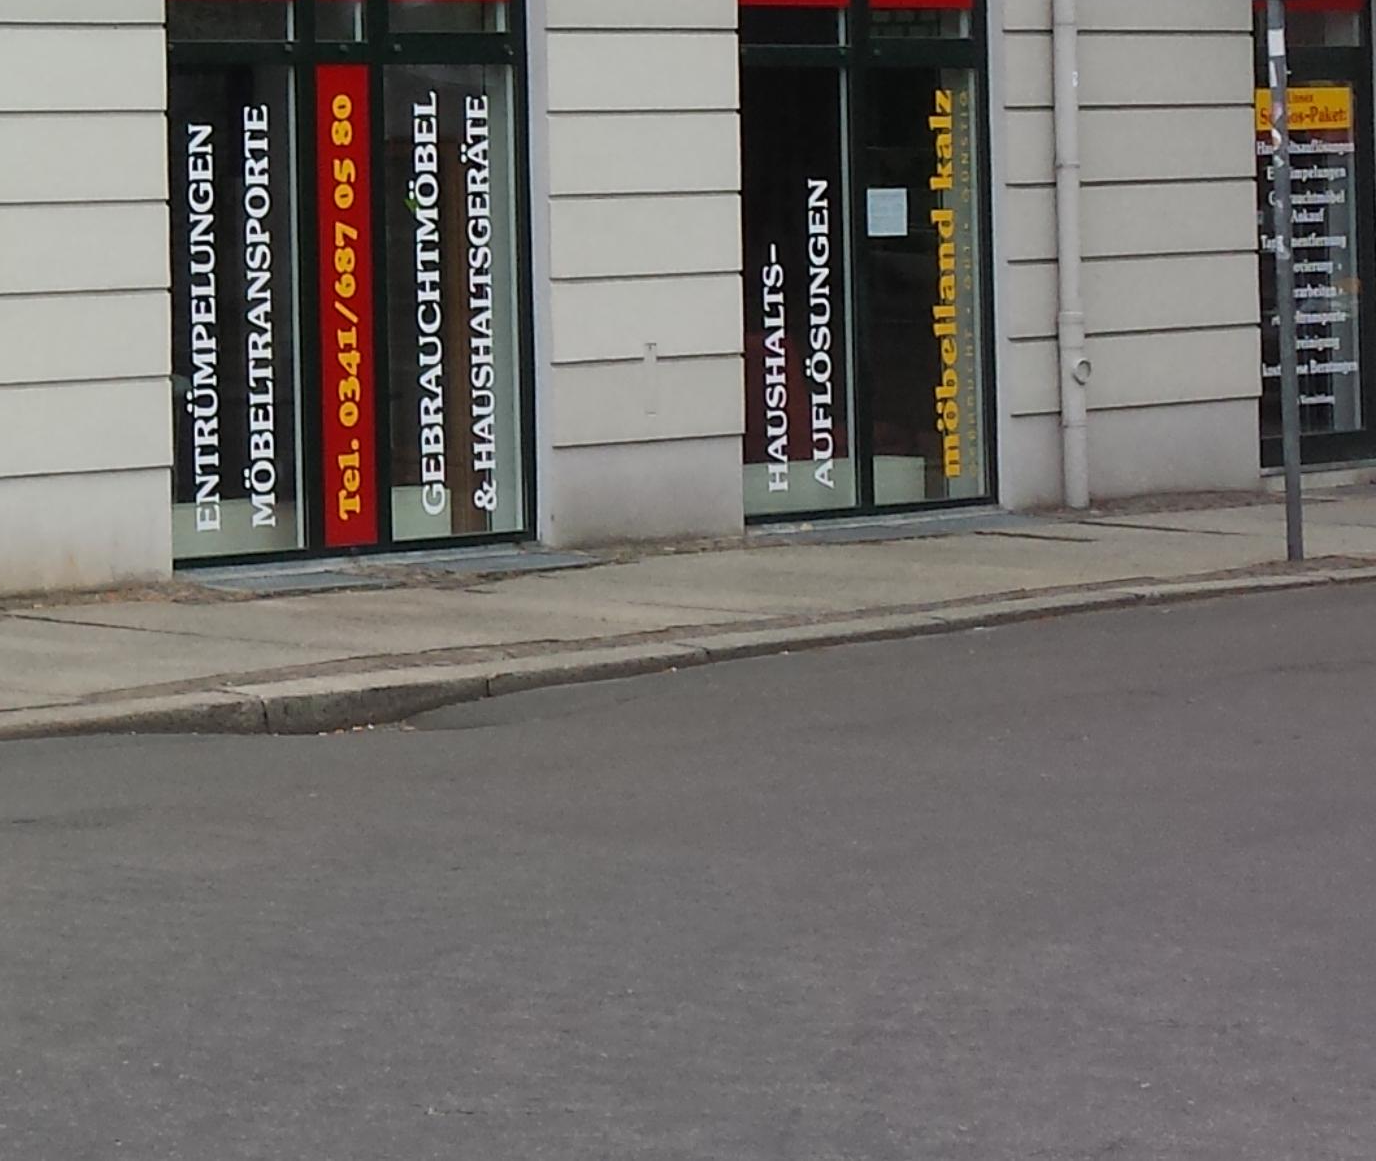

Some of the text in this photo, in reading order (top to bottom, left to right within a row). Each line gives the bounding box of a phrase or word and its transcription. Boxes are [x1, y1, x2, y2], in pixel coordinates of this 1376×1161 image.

[331, 94, 352, 146] 80
[333, 158, 356, 209] 05
[929, 90, 961, 478] möbelland kalz
[186, 123, 221, 532] ENTRÜMPELUNGEN
[243, 104, 276, 528] MÖBELTRANSPORTE
[408, 91, 446, 516] GEBRAUCHTMÖBEL
[460, 95, 496, 512] & HAUSHALTSGERÄTE
[762, 243, 788, 492] HAUSHALTS-
[806, 178, 834, 488] AUFLÖSUNGEN
[338, 439, 361, 520] Tel.
